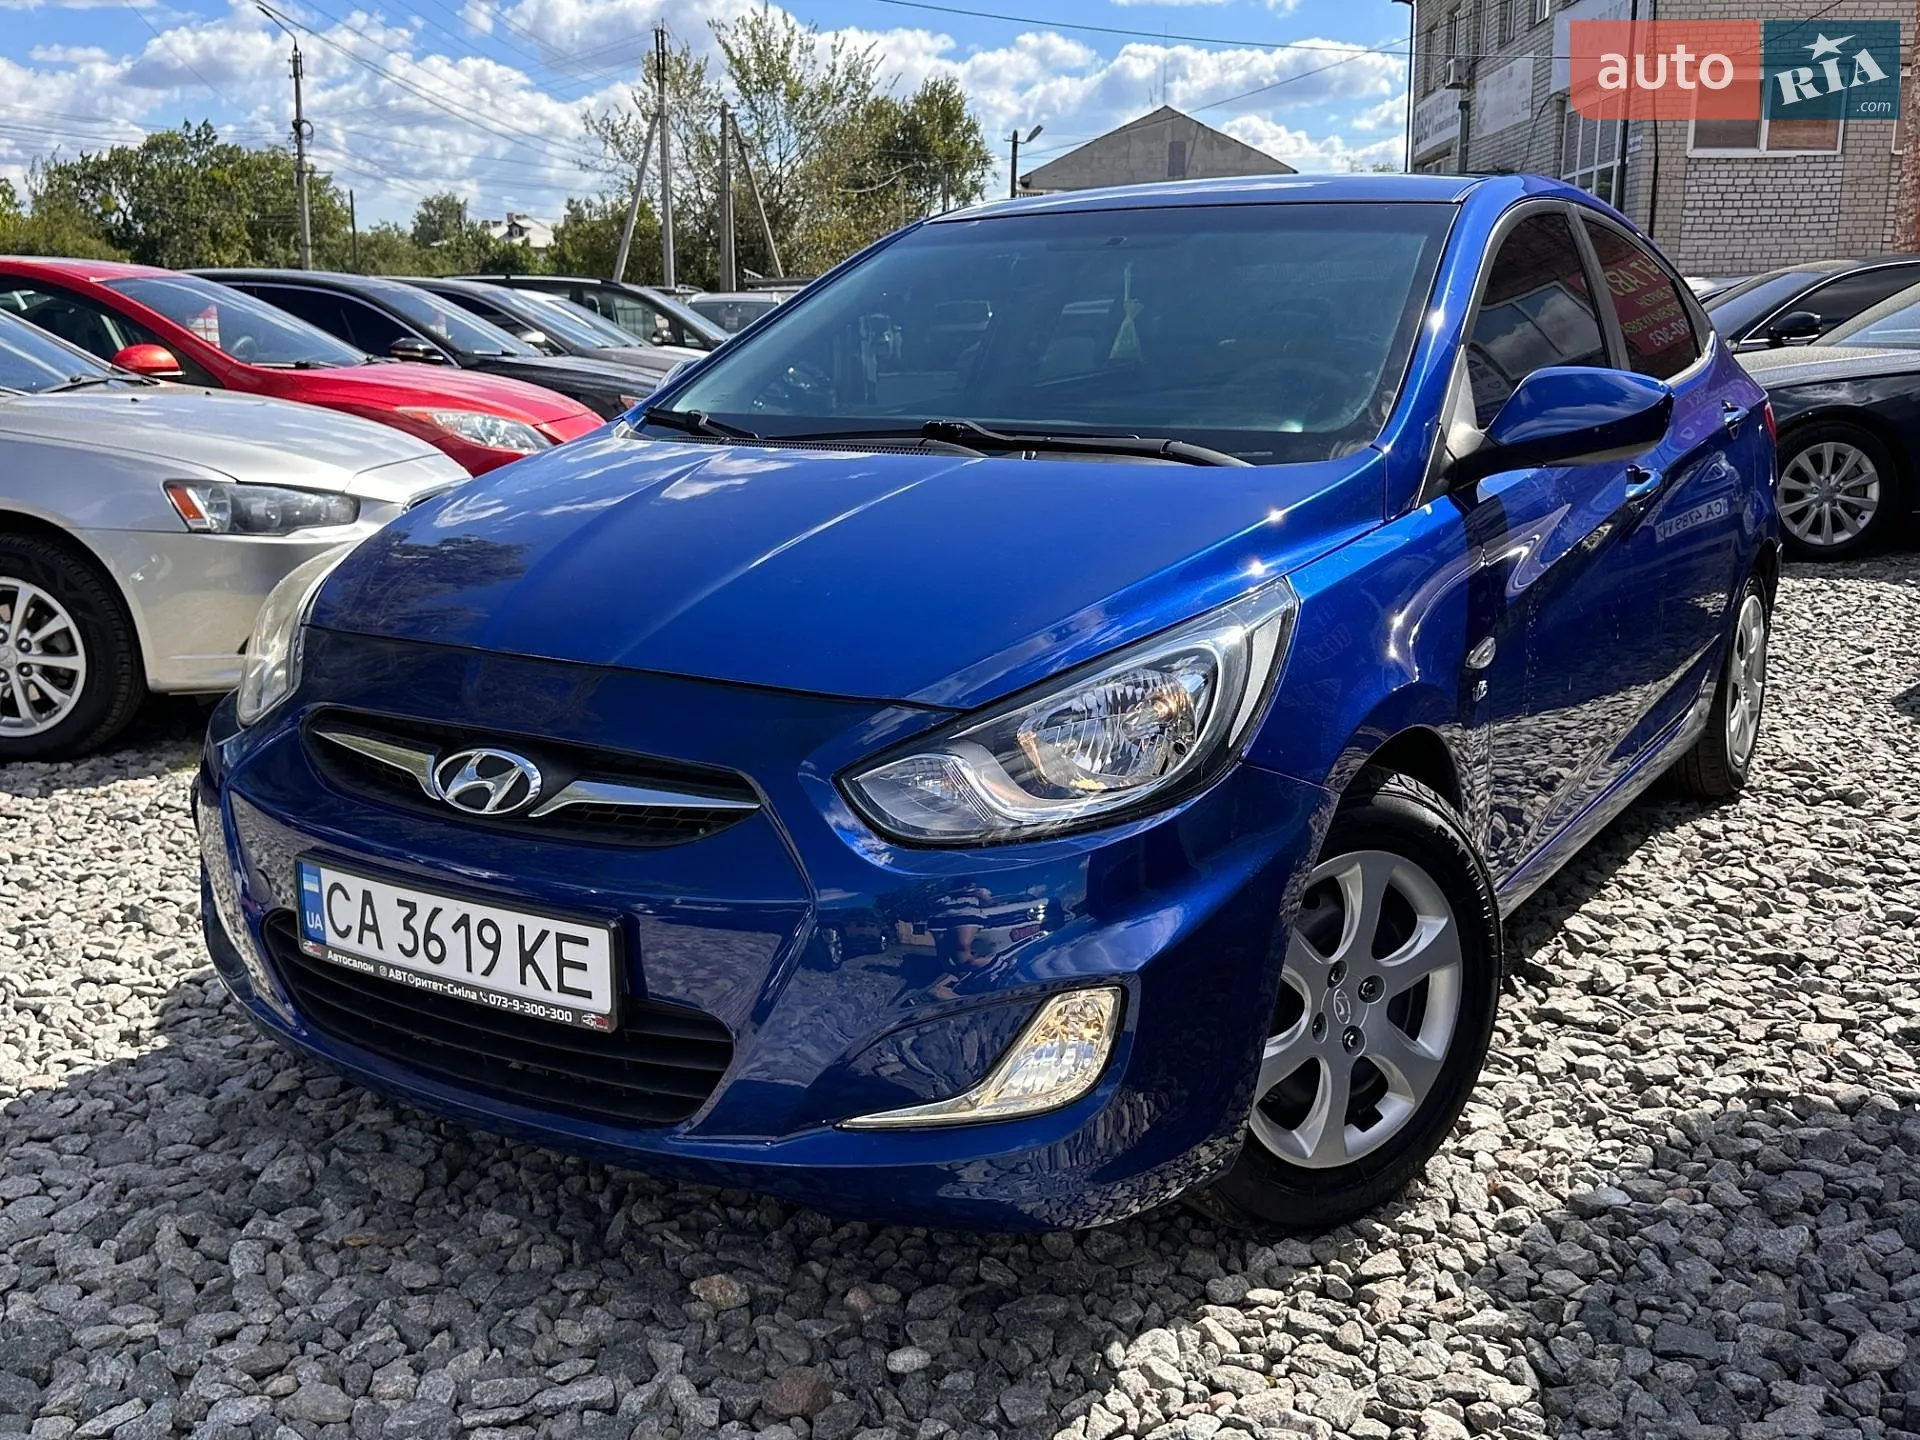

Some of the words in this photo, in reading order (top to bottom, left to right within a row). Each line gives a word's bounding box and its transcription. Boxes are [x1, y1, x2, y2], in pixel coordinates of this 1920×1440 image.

[306, 910, 324, 931] UA
[326, 882, 384, 951] CA
[396, 898, 502, 977] 3619
[517, 924, 593, 1000] KE
[328, 950, 374, 973] Автосалон
[489, 994, 572, 1022] 073-9-300-300
